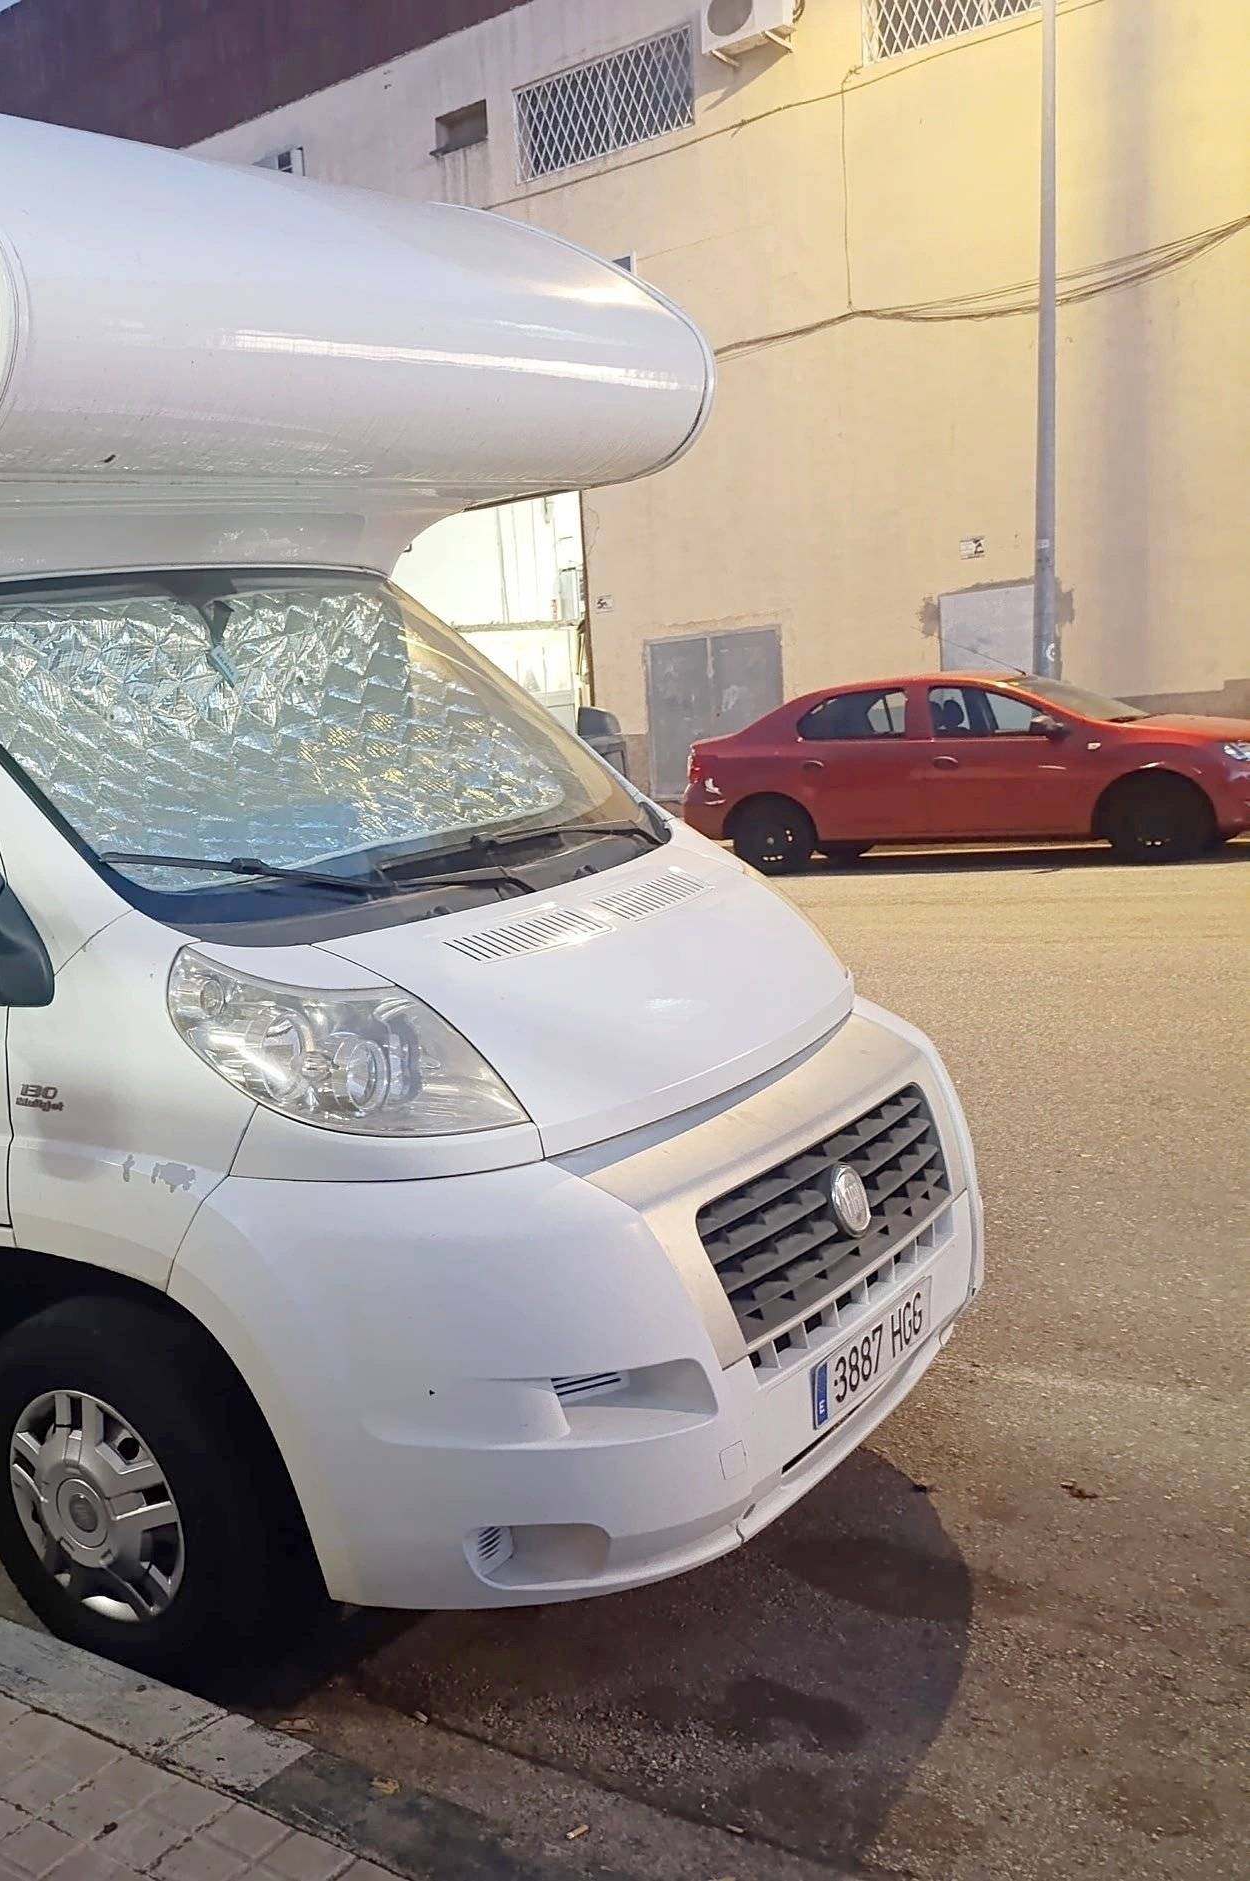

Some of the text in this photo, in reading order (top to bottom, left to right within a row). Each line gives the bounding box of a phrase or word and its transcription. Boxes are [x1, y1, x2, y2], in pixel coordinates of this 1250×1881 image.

[833, 1291, 923, 1403] 3887 HGG
[818, 1399, 827, 1415] E
